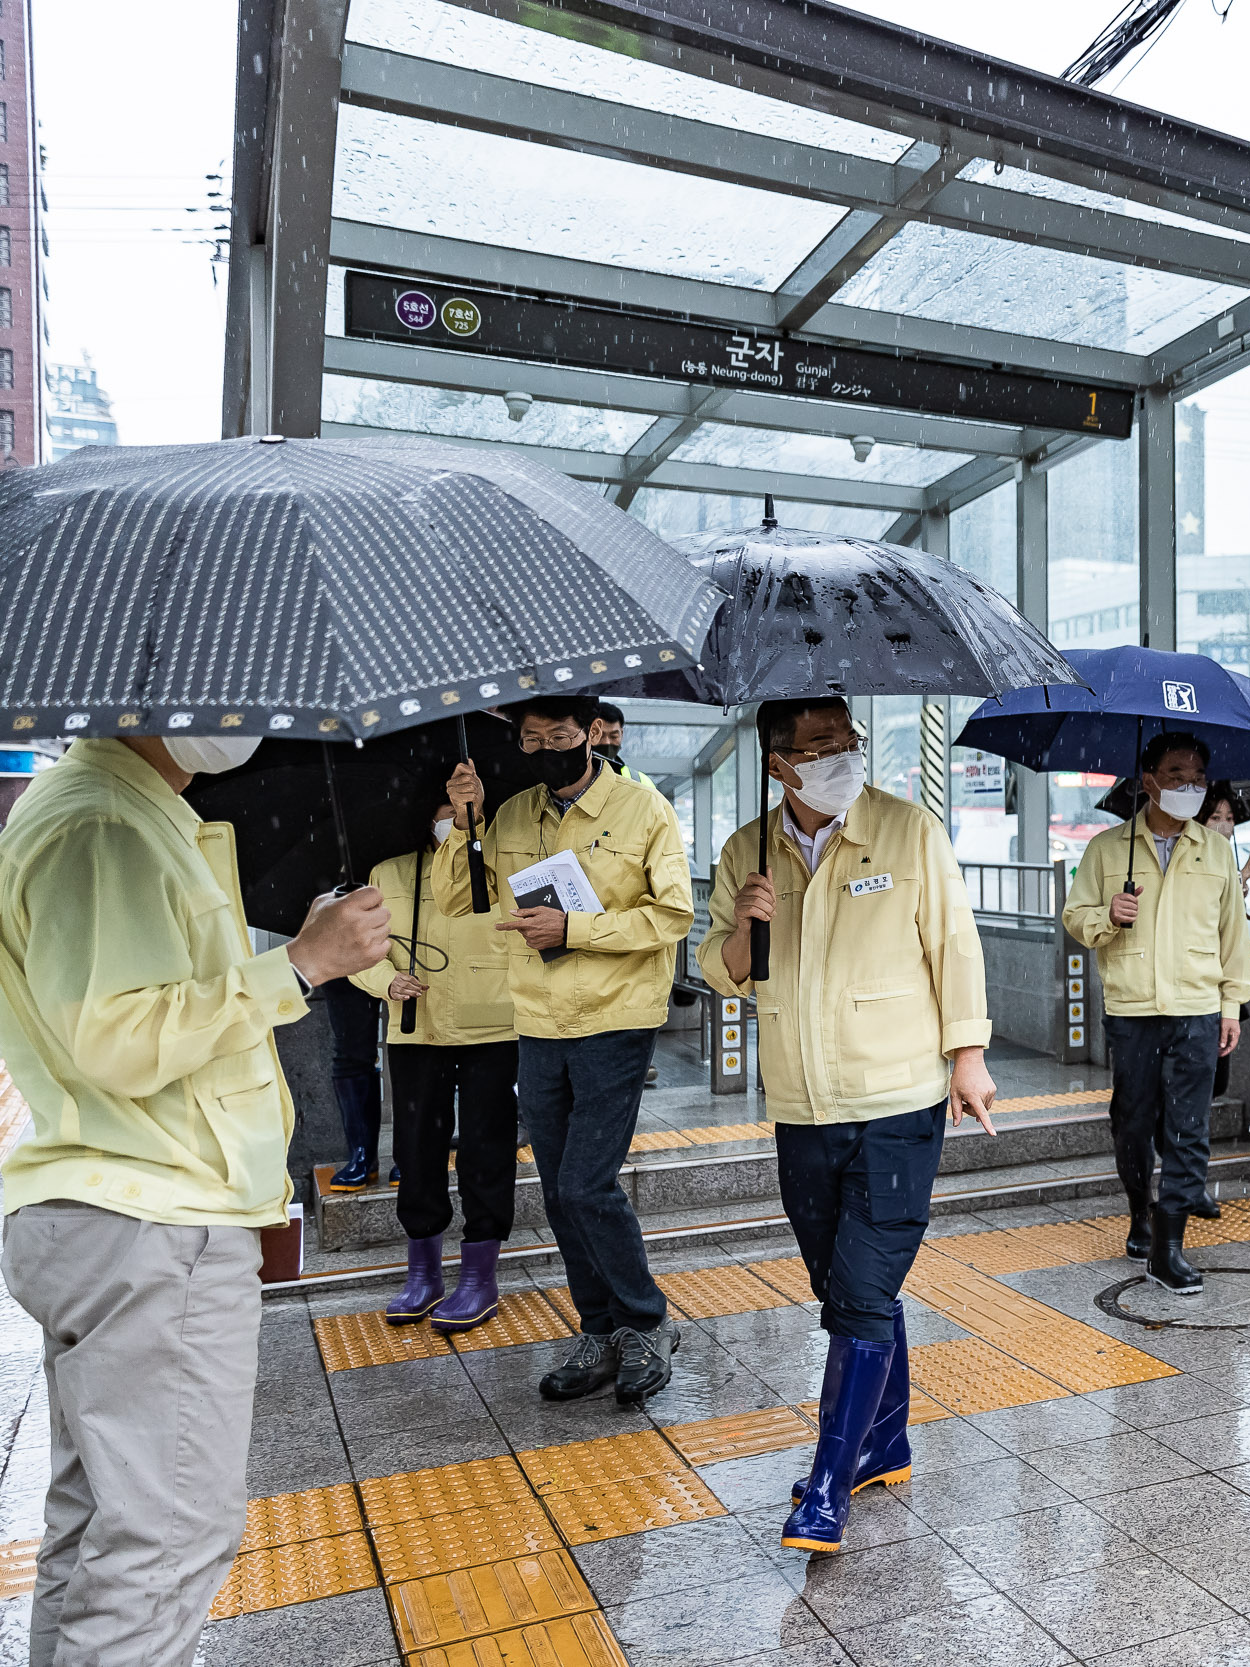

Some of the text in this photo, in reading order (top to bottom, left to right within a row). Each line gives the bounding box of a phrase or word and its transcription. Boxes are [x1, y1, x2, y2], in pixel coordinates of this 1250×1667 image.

[403, 300, 429, 314] 5호선
[449, 308, 474, 320] 7호선
[408, 314, 424, 324] 544
[454, 321, 469, 330] 725
[726, 336, 784, 372] 군자
[712, 364, 783, 386] Neung-dong)
[796, 362, 828, 377] Gunja
[831, 382, 871, 398] クンジャ
[1088, 392, 1096, 415] 1
